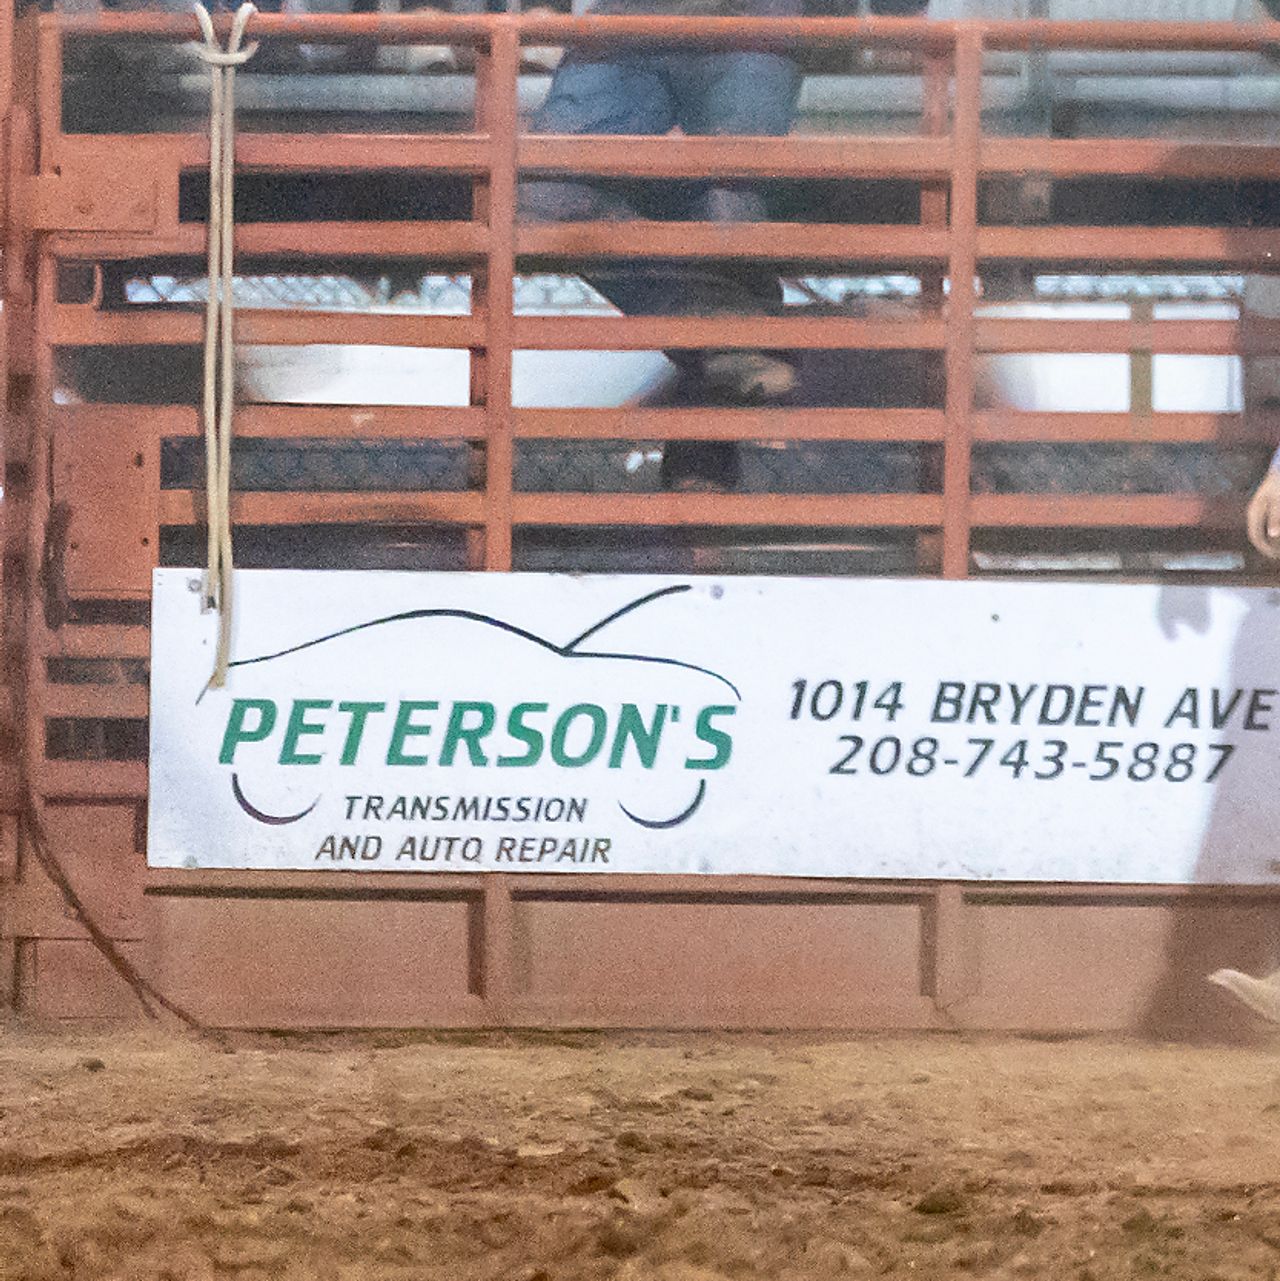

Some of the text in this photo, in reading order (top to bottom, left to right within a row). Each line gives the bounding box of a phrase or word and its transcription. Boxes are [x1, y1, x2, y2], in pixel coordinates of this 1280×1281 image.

[789, 678, 1279, 731] 1014 BRYDEN AVE
[218, 697, 738, 772] PETERSON'S
[829, 734, 1236, 782] 208-743-5887
[344, 794, 588, 824] TRANSMISSION
[314, 834, 612, 865] AND AUTO REPAIR
